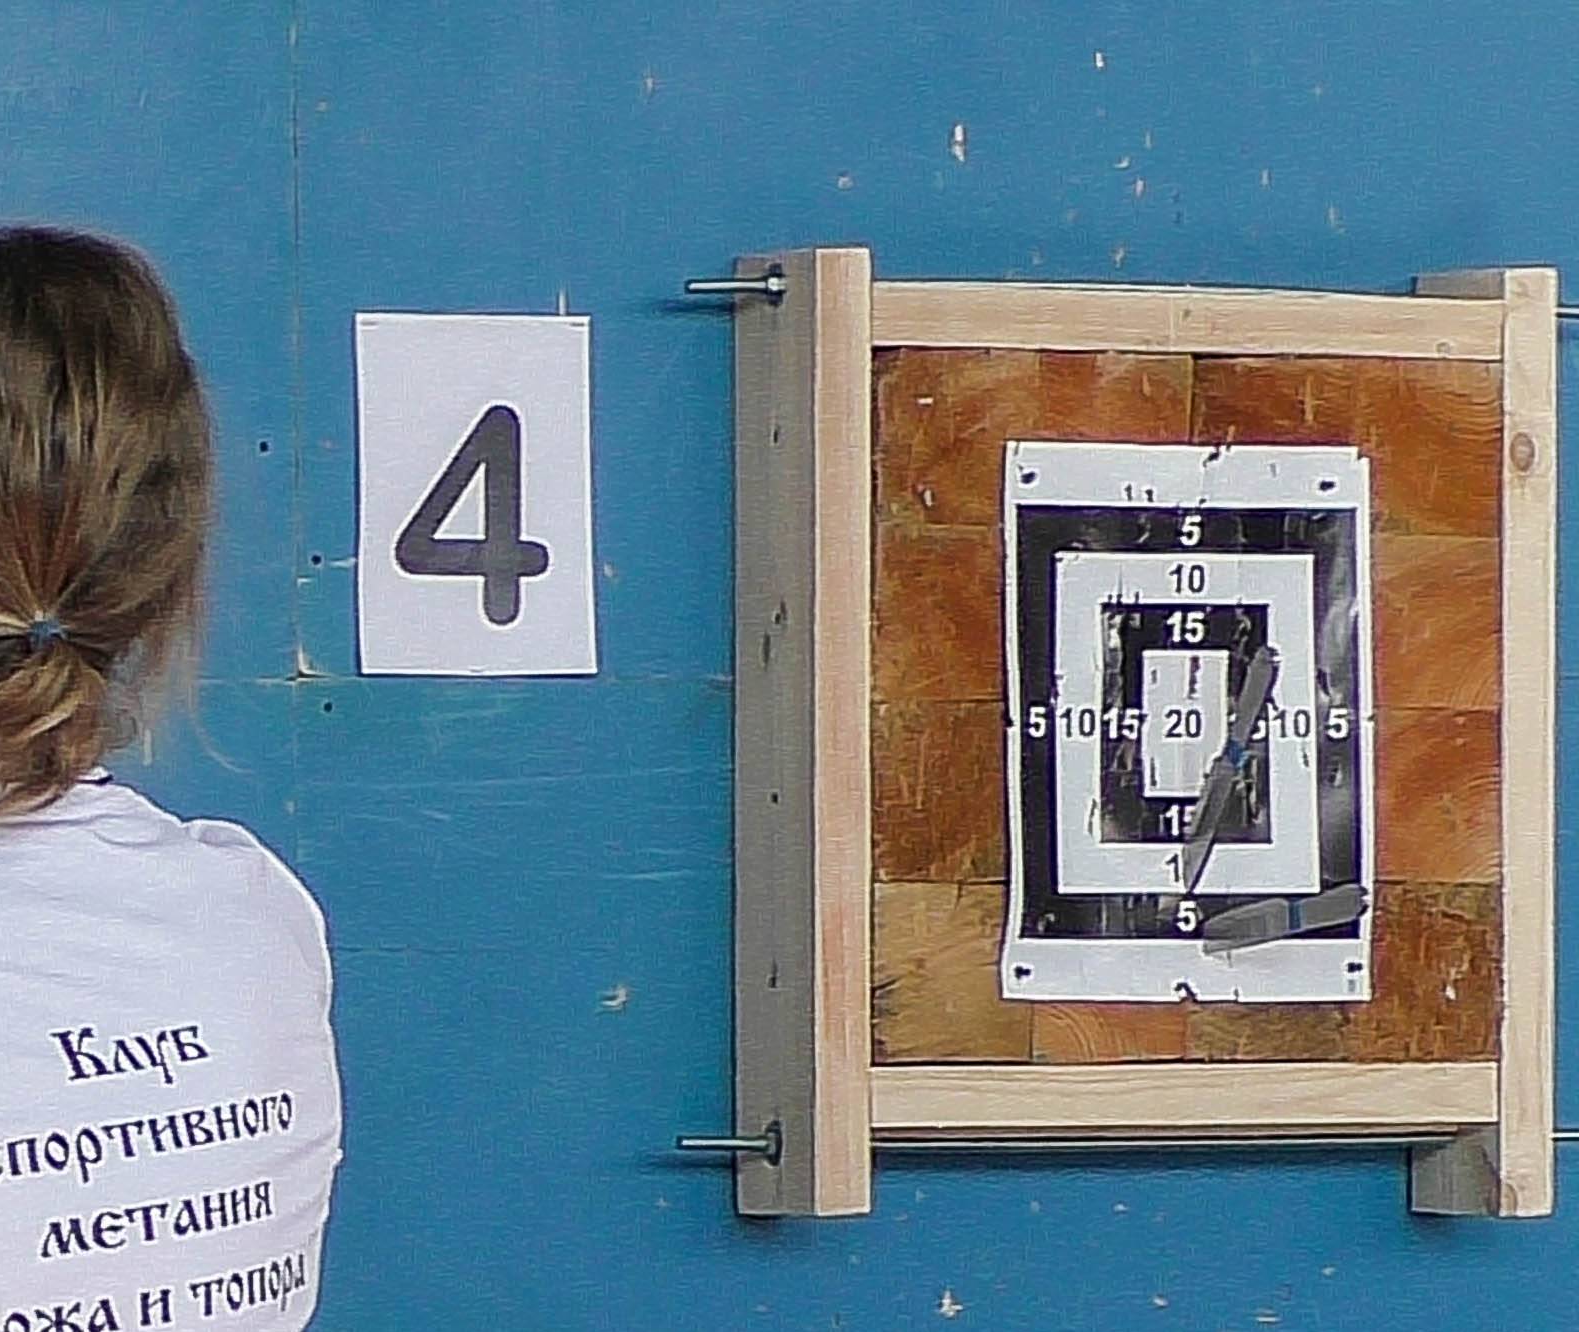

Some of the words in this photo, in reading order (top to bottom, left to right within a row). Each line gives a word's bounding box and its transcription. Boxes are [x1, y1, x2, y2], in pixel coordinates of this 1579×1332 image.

[395, 405, 549, 625] 4
[1180, 515, 1201, 546] 5
[1169, 566, 1205, 594] 10
[1167, 611, 1205, 643] 15
[1028, 710, 1047, 738] 5
[1060, 710, 1095, 738] 10
[1103, 710, 1140, 740] 15
[1165, 709, 1201, 738] 20
[1273, 709, 1310, 738] 10
[1327, 708, 1349, 739] 5
[1176, 901, 1198, 931] 5
[53, 1026, 209, 1084] Клуб
[42, 1181, 273, 1257] метания
[140, 1289, 172, 1325] и
